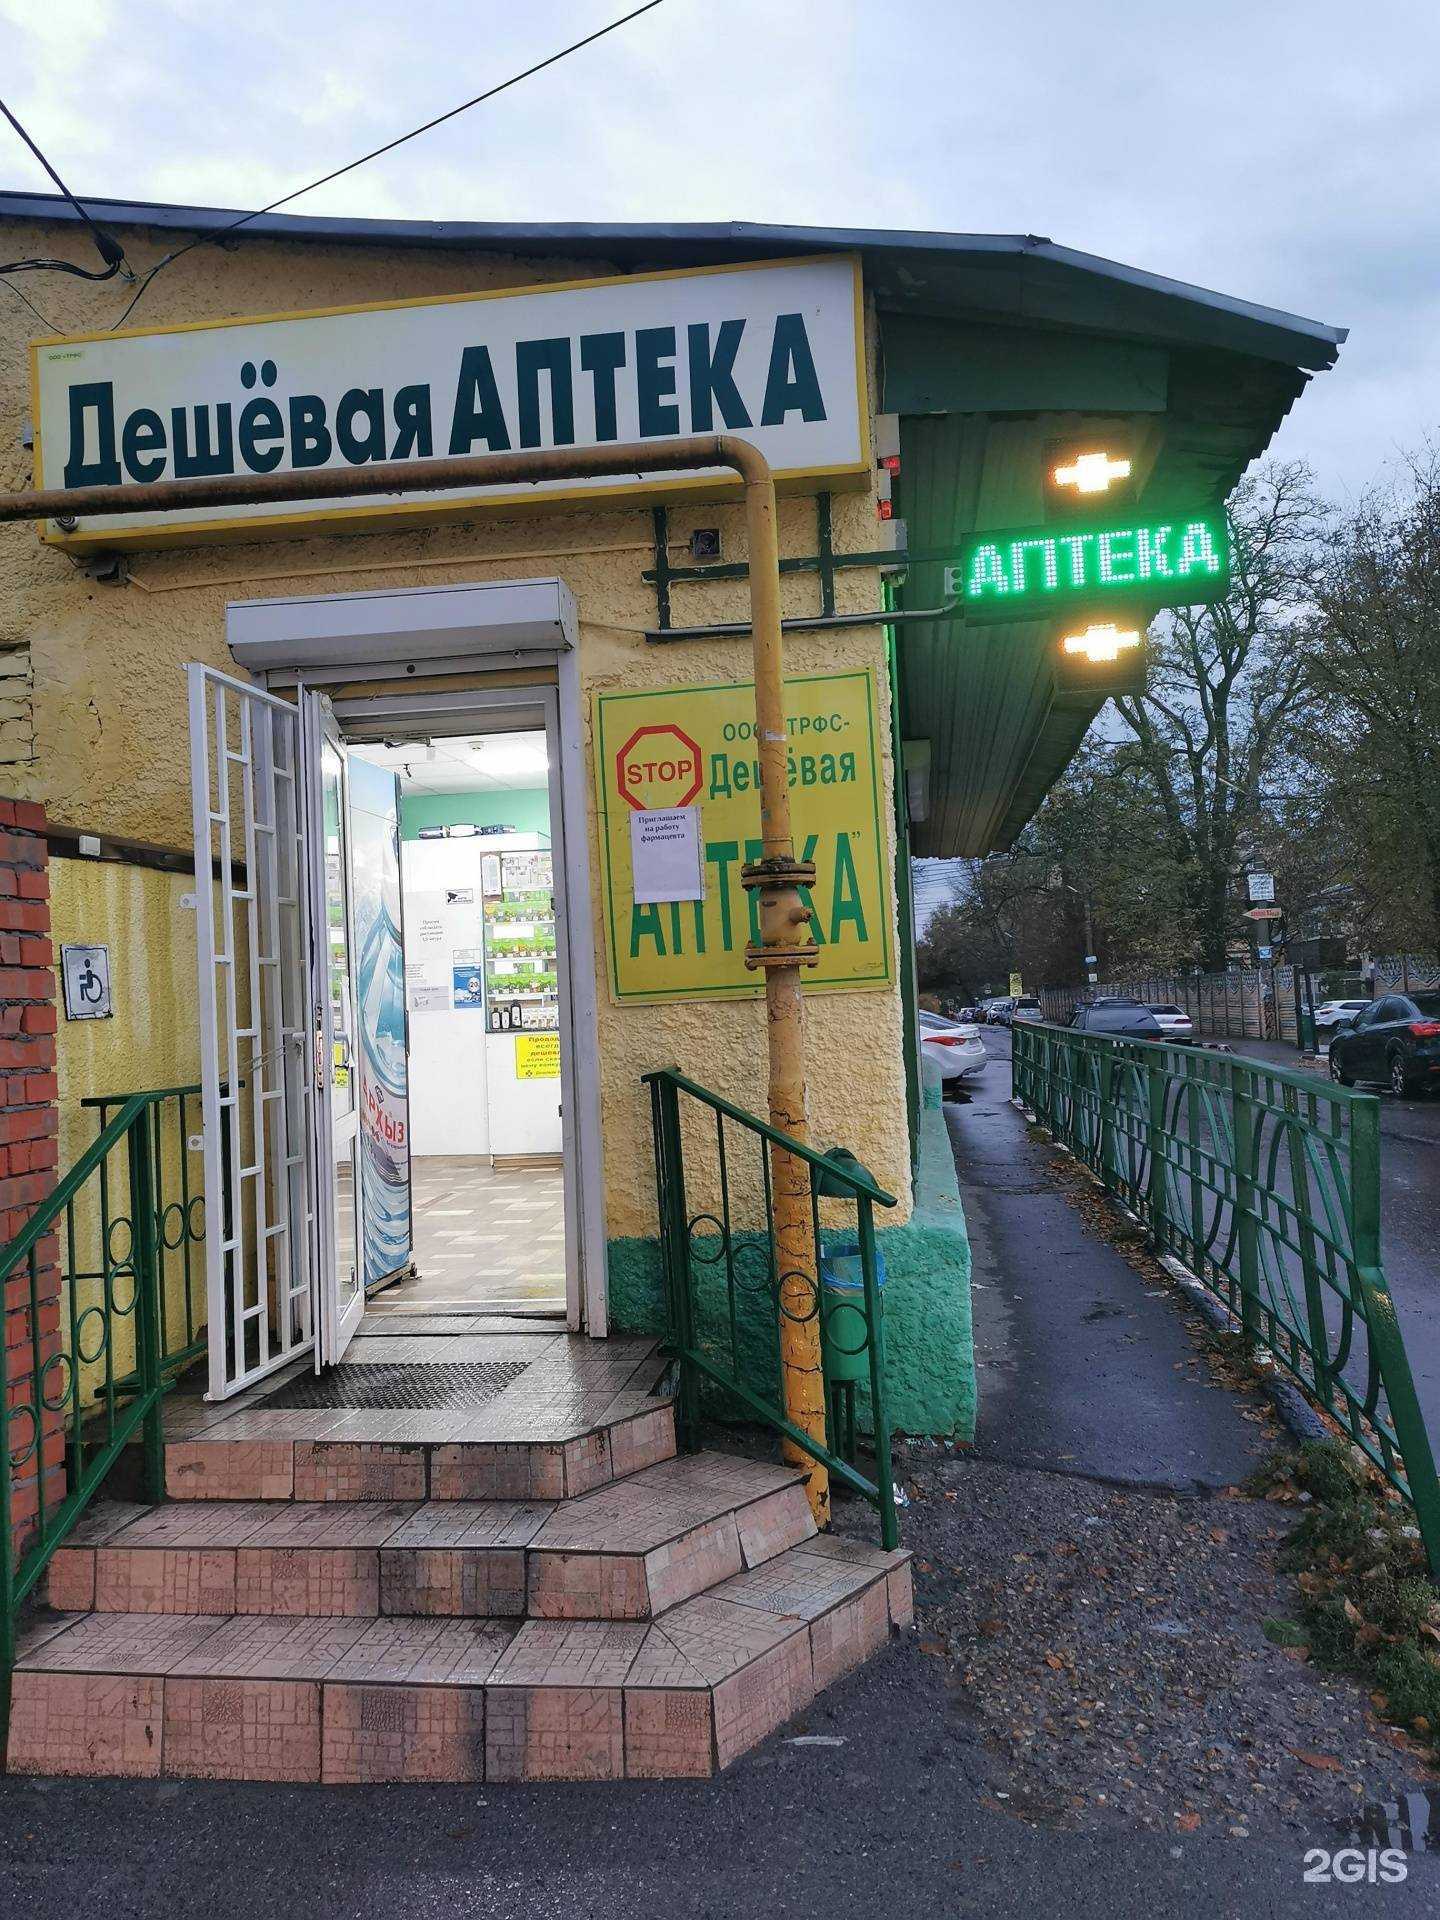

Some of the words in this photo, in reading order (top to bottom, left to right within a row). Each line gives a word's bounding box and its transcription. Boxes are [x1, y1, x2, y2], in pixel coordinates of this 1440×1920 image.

[63, 358, 433, 490] Дешёвая
[448, 312, 828, 456] АПТЕКА
[969, 521, 1220, 595] АПТЕКА
[627, 759, 693, 785] STOP
[638, 813, 687, 825] Приглашаем
[655, 823, 680, 834] работу
